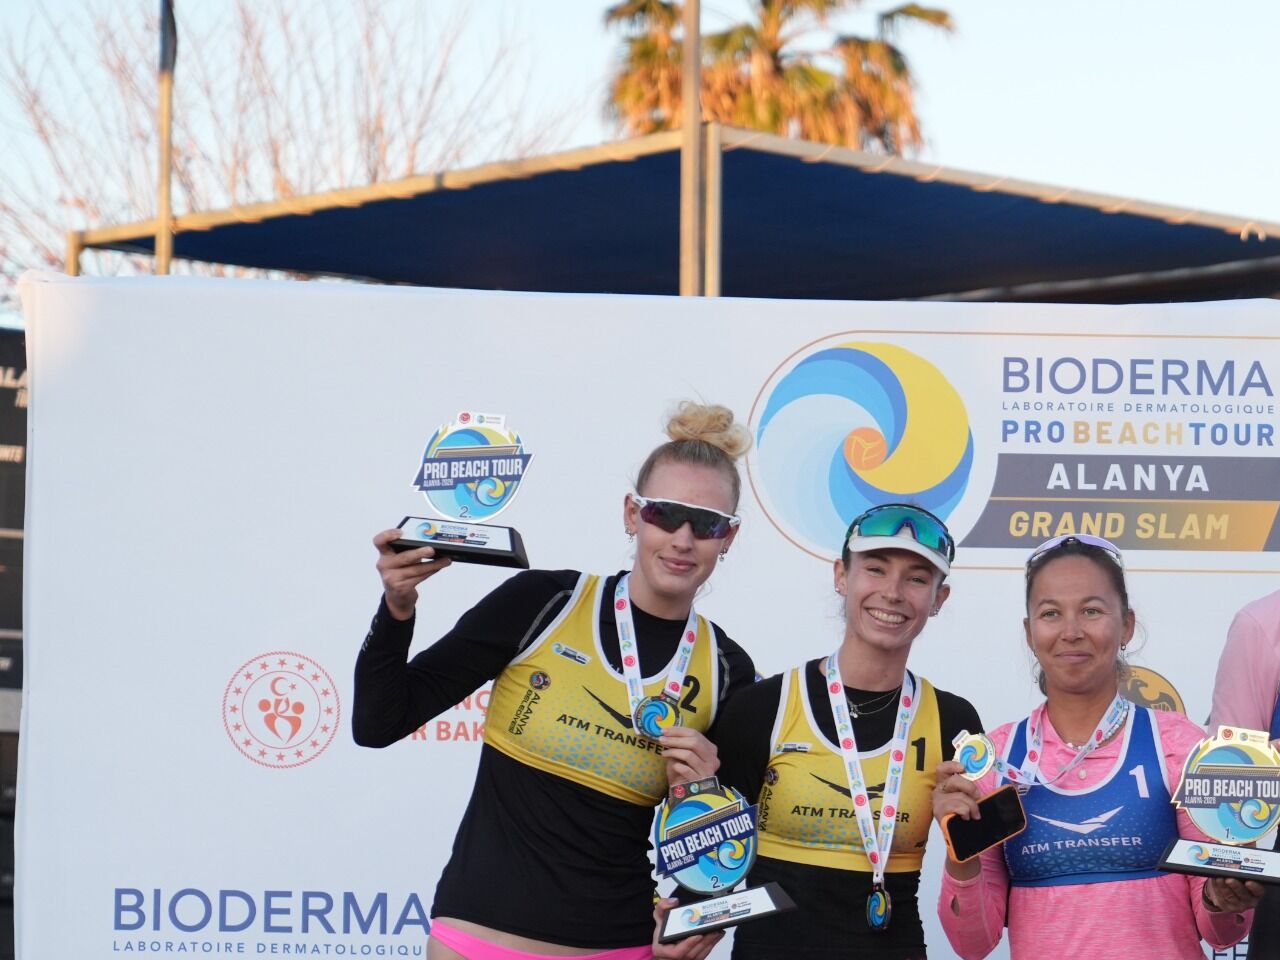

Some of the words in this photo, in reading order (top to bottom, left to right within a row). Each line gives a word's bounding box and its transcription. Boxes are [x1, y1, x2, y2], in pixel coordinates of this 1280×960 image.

[1002, 356, 1274, 397] BIODERMA
[1002, 401, 1115, 412] LABORATOIRE
[1124, 403, 1275, 415] DERMATOLOGIQUE
[423, 462, 448, 480] PRO
[450, 459, 490, 479] BEACH
[491, 457, 523, 477] TOUR
[1046, 462, 1209, 492] ALANYA
[1009, 511, 1126, 538] GRAND
[1135, 513, 1230, 540] SLAM
[680, 674, 701, 714] 2
[514, 691, 541, 736] ALANYA
[556, 713, 591, 731] ATM
[594, 724, 670, 756] TRANSFE
[911, 737, 926, 772] 1
[1129, 764, 1150, 798] 1
[1184, 779, 1210, 796] PRO
[1213, 779, 1253, 798] BEACH
[791, 805, 824, 818] ATM
[827, 807, 911, 823] TRASER
[660, 839, 684, 864] PRO
[686, 825, 724, 855] BEACH
[723, 813, 754, 839] TOUR
[1021, 842, 1051, 856] ATM
[1054, 837, 1143, 850] TRANSFER
[113, 887, 431, 936] BIODERMA
[113, 941, 245, 953] LABORATOIRE
[256, 943, 422, 956] DERMATOLOGIQU
